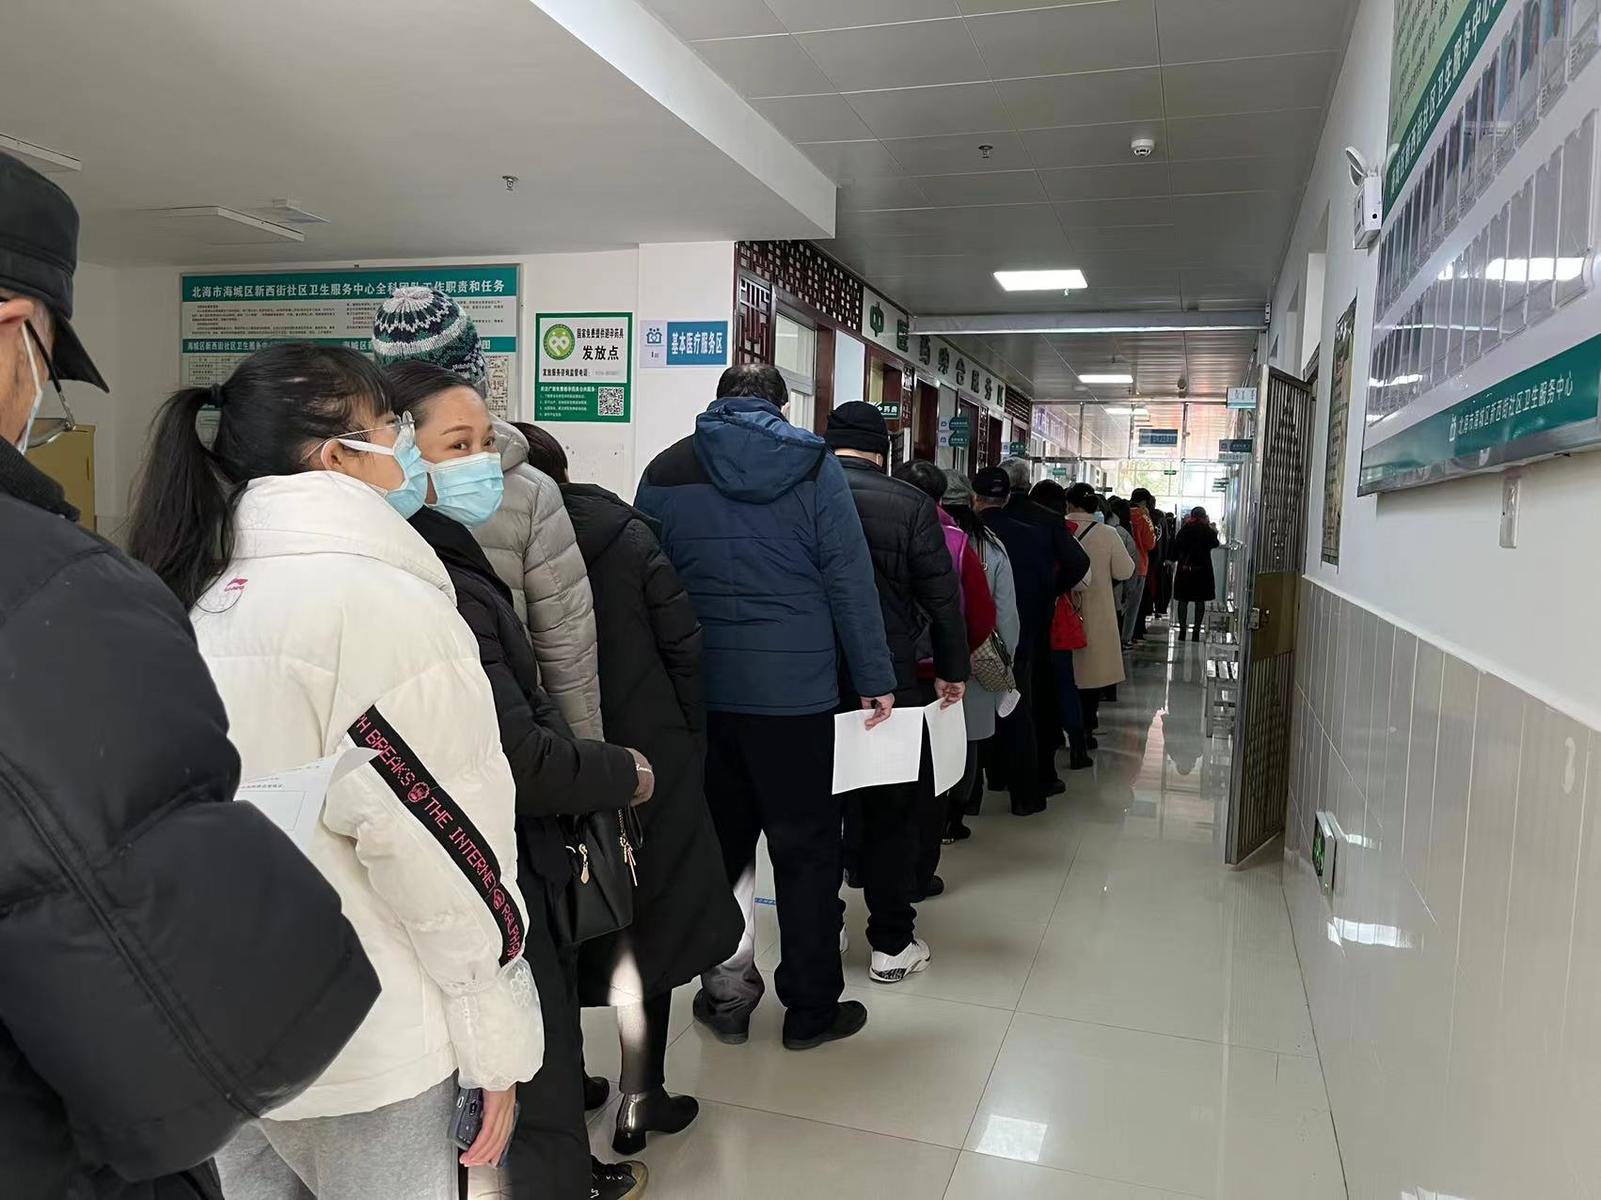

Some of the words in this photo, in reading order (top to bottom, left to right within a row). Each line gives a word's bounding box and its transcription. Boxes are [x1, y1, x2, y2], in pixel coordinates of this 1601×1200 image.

[582, 345, 619, 361] 发放点
[671, 331, 723, 355] 基本医疗服务区
[1457, 370, 1574, 436] 北海市海城区新西街社区卫生服务中心
[365, 729, 416, 786] BREAKS
[424, 797, 454, 829] THE
